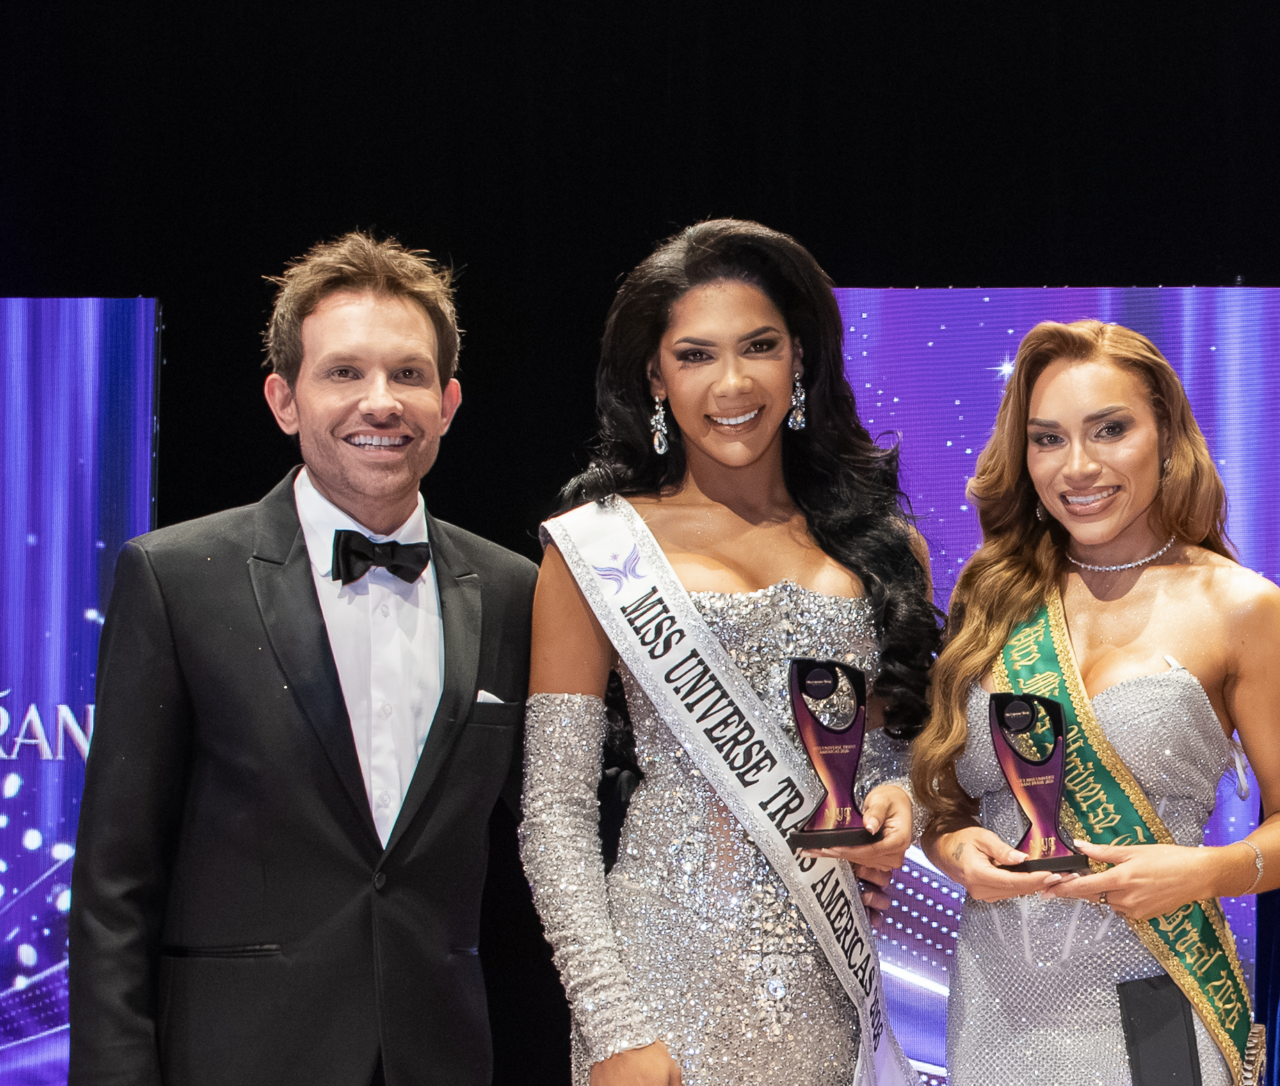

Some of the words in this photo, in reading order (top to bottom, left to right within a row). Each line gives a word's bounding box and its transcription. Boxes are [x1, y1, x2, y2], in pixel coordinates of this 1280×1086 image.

[620, 585, 686, 660] MISS
[664, 648, 778, 788] UNIVERSE
[811, 866, 875, 998] AMERICAS
[1205, 970, 1243, 1031] 2026
